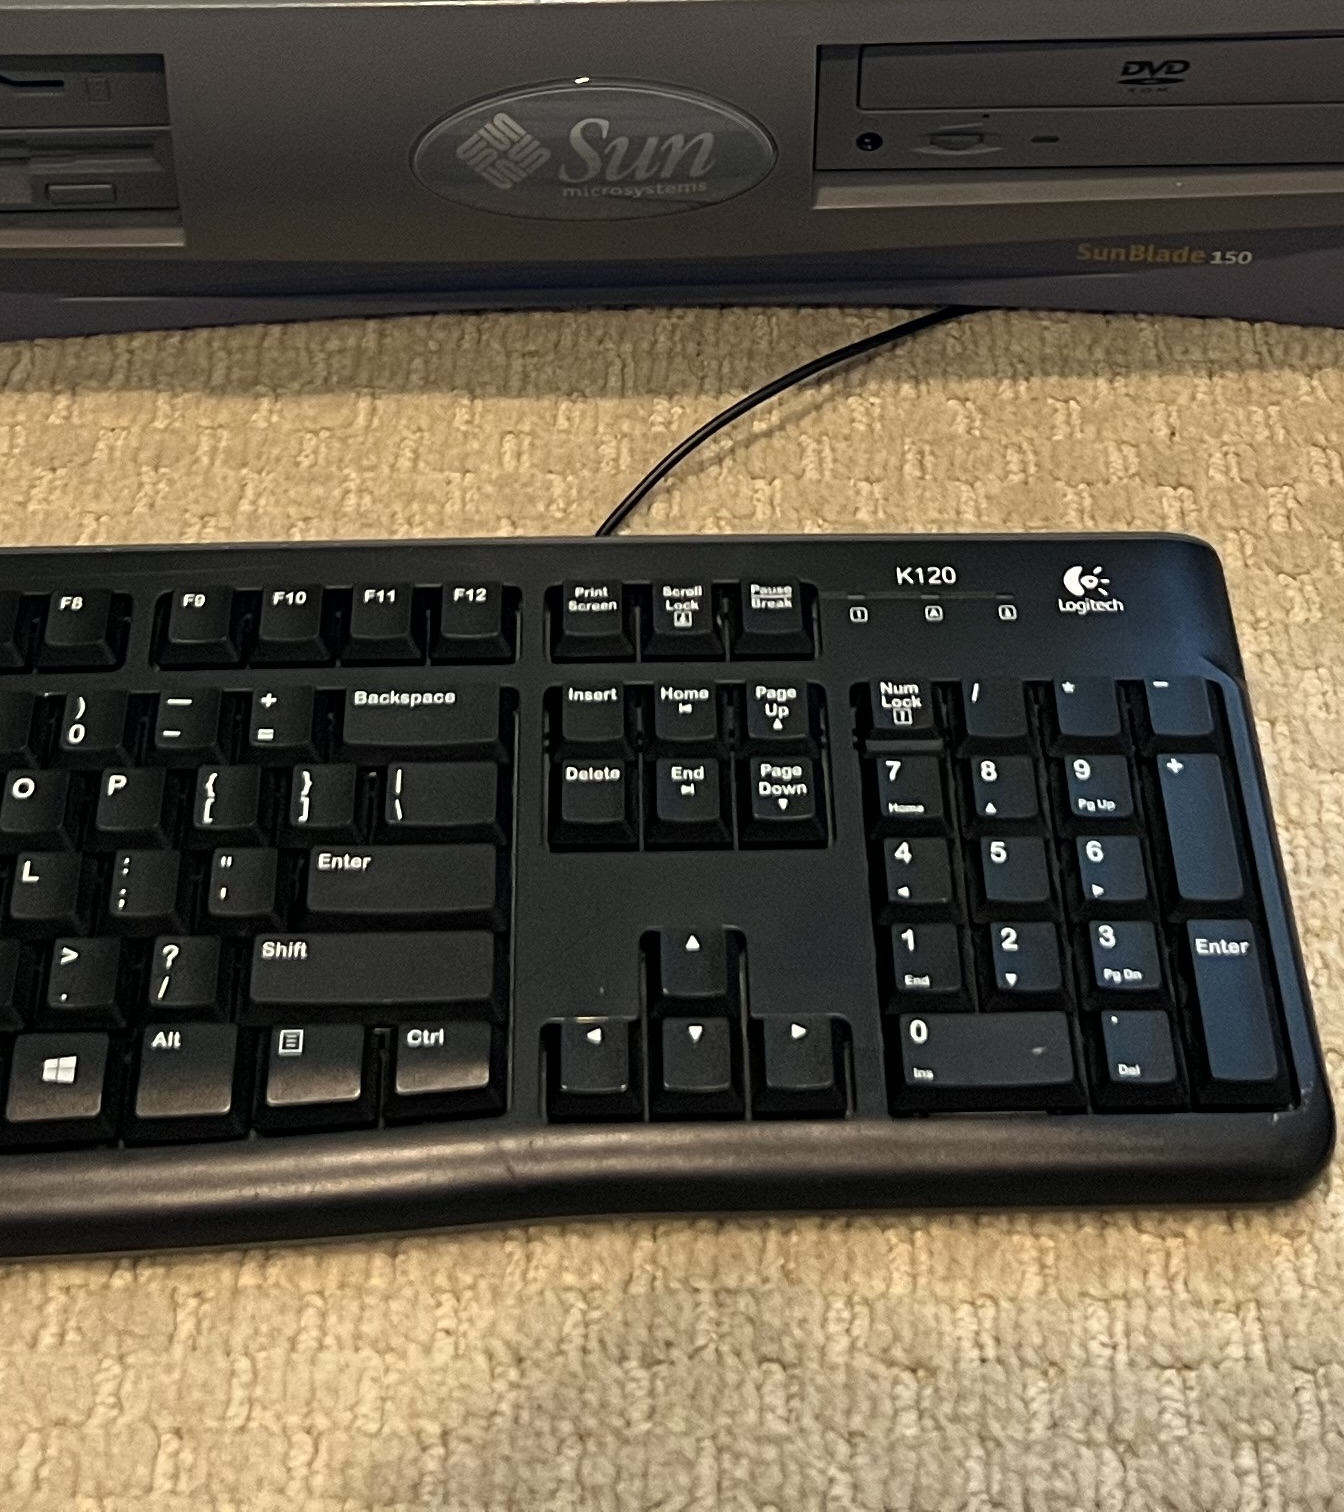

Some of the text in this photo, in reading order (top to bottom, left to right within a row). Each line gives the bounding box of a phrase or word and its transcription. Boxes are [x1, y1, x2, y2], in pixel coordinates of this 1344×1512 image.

[1120, 59, 1191, 77] DVD
[560, 117, 717, 183] Sun
[562, 180, 708, 200] microsystems
[1209, 250, 1254, 266] 150
[896, 566, 957, 586] K120
[272, 590, 307, 606] F10
[364, 589, 396, 604] F11
[453, 587, 487, 602] F12
[574, 586, 609, 598] Print
[59, 596, 83, 610] F8
[182, 593, 206, 608] F9
[568, 600, 618, 612] Screen
[665, 599, 700, 611] Lock
[1058, 597, 1125, 615] Logitech
[568, 687, 618, 702] Insert
[660, 686, 710, 701] Home
[755, 685, 797, 702] Page
[879, 681, 919, 697] Num
[354, 690, 456, 708] Backspace
[881, 693, 922, 710] Lock
[764, 702, 790, 720] Up
[565, 766, 621, 781] Delete
[670, 765, 705, 781] End
[760, 763, 803, 781] Page
[758, 781, 808, 796] Down
[1096, 798, 1116, 811] Up
[317, 852, 372, 871] Enter
[262, 941, 308, 960] Shift
[1195, 938, 1249, 955] Enter
[904, 974, 930, 987] End
[150, 1031, 181, 1049] Alt
[406, 1028, 445, 1047] Ctrl
